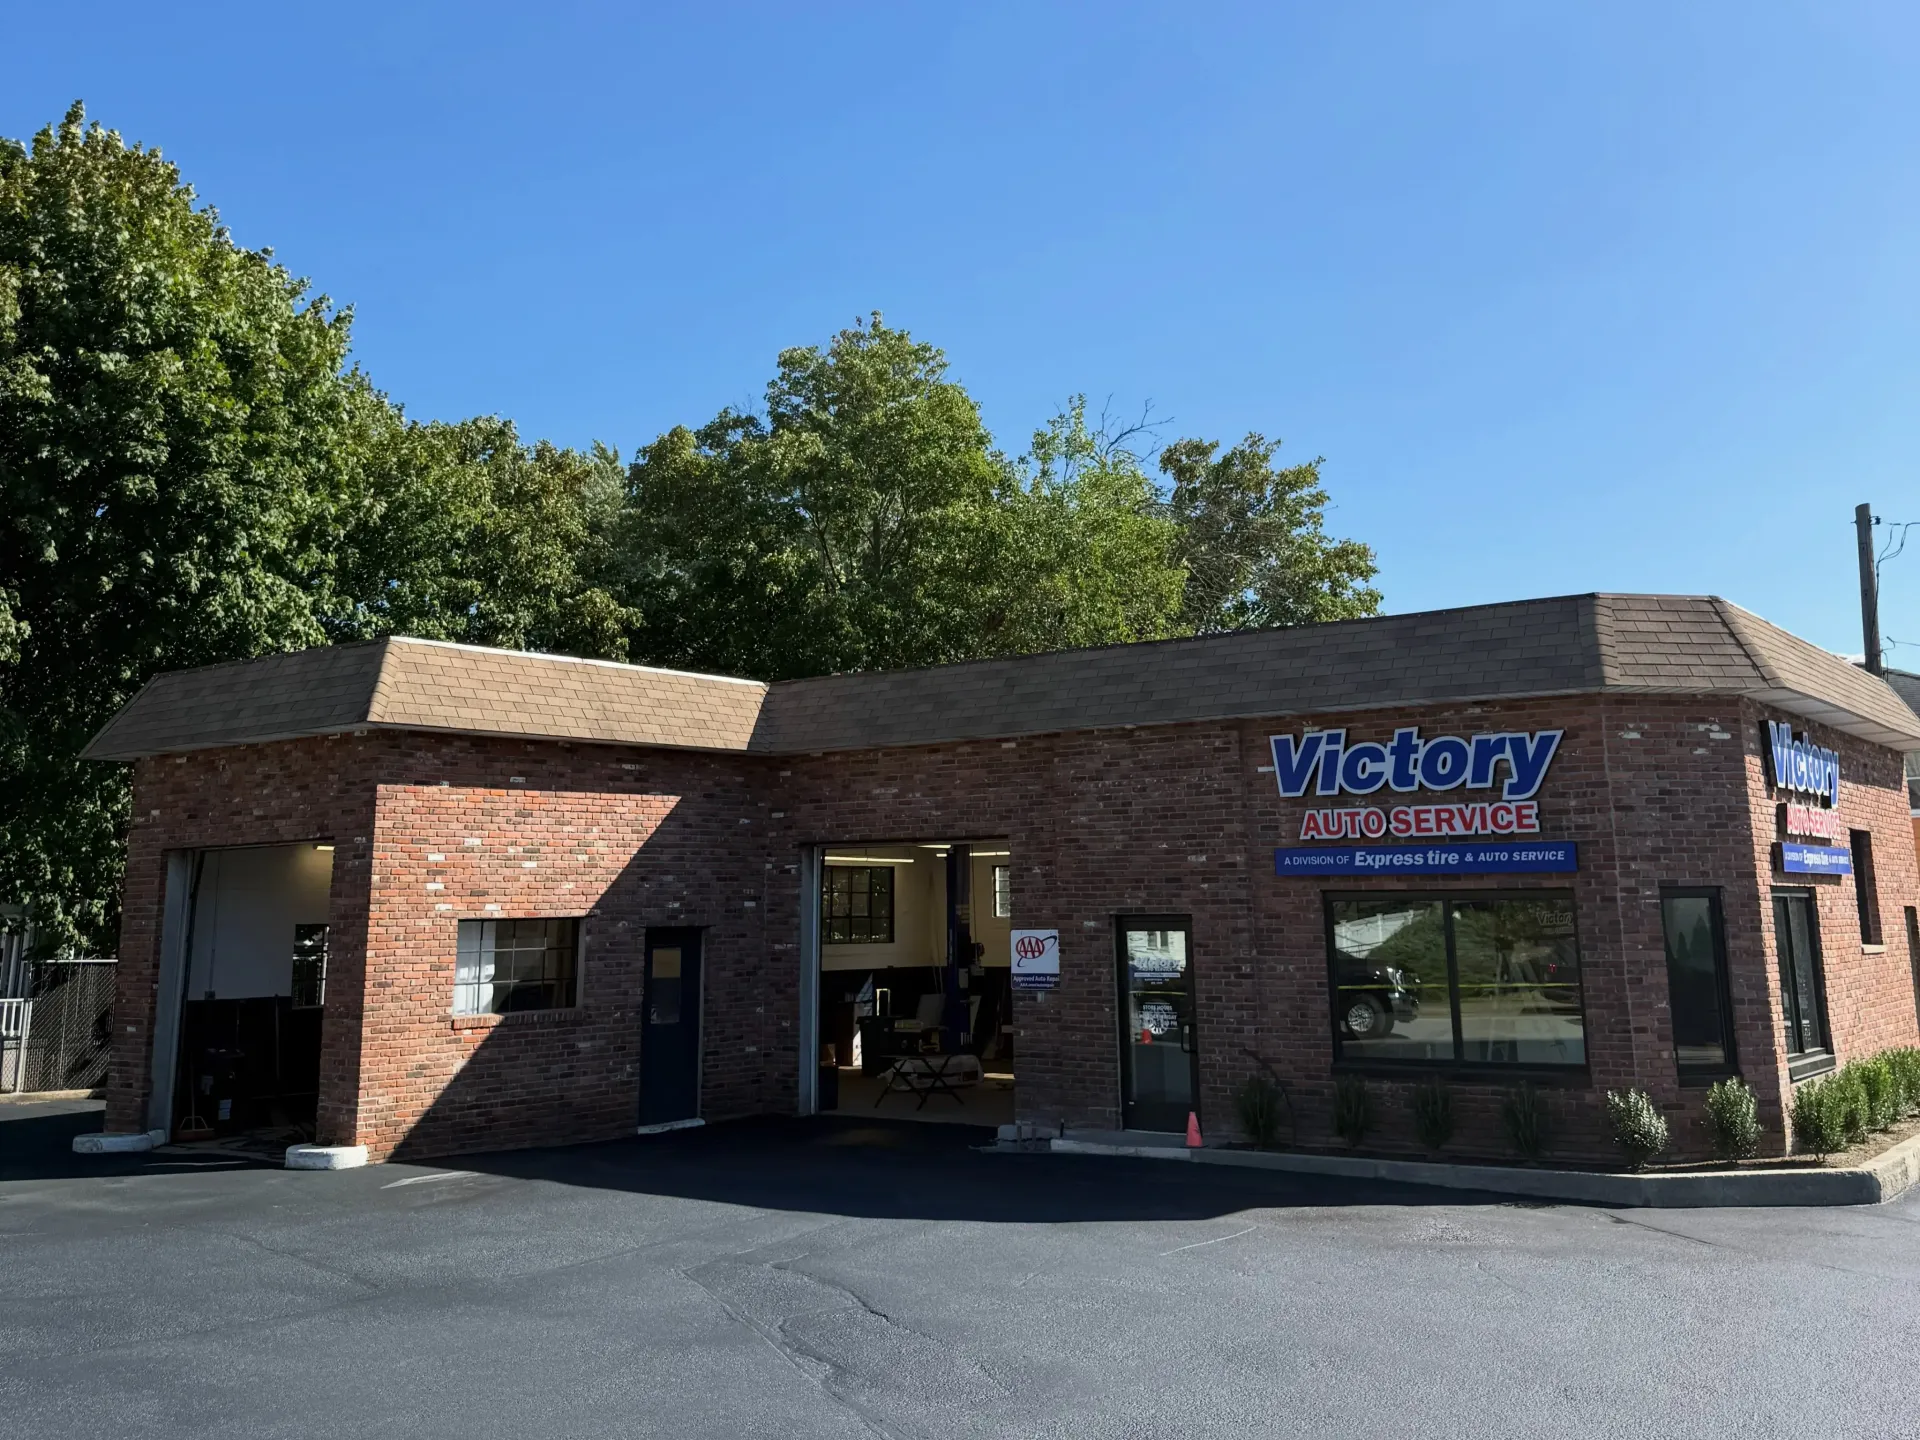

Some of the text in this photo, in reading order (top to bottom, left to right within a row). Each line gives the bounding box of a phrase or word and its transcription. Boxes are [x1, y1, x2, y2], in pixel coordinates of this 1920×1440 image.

[1270, 727, 1564, 800] Victory
[1768, 720, 1839, 809] Victory
[1300, 801, 1540, 839] AUTO SERVICE
[1786, 803, 1810, 836] AUTO
[1284, 850, 1566, 869] A DIVISION OF Express tire & AUTO SERVICE
[1019, 937, 1043, 958] AAA
[1013, 975, 1035, 983] Approved
